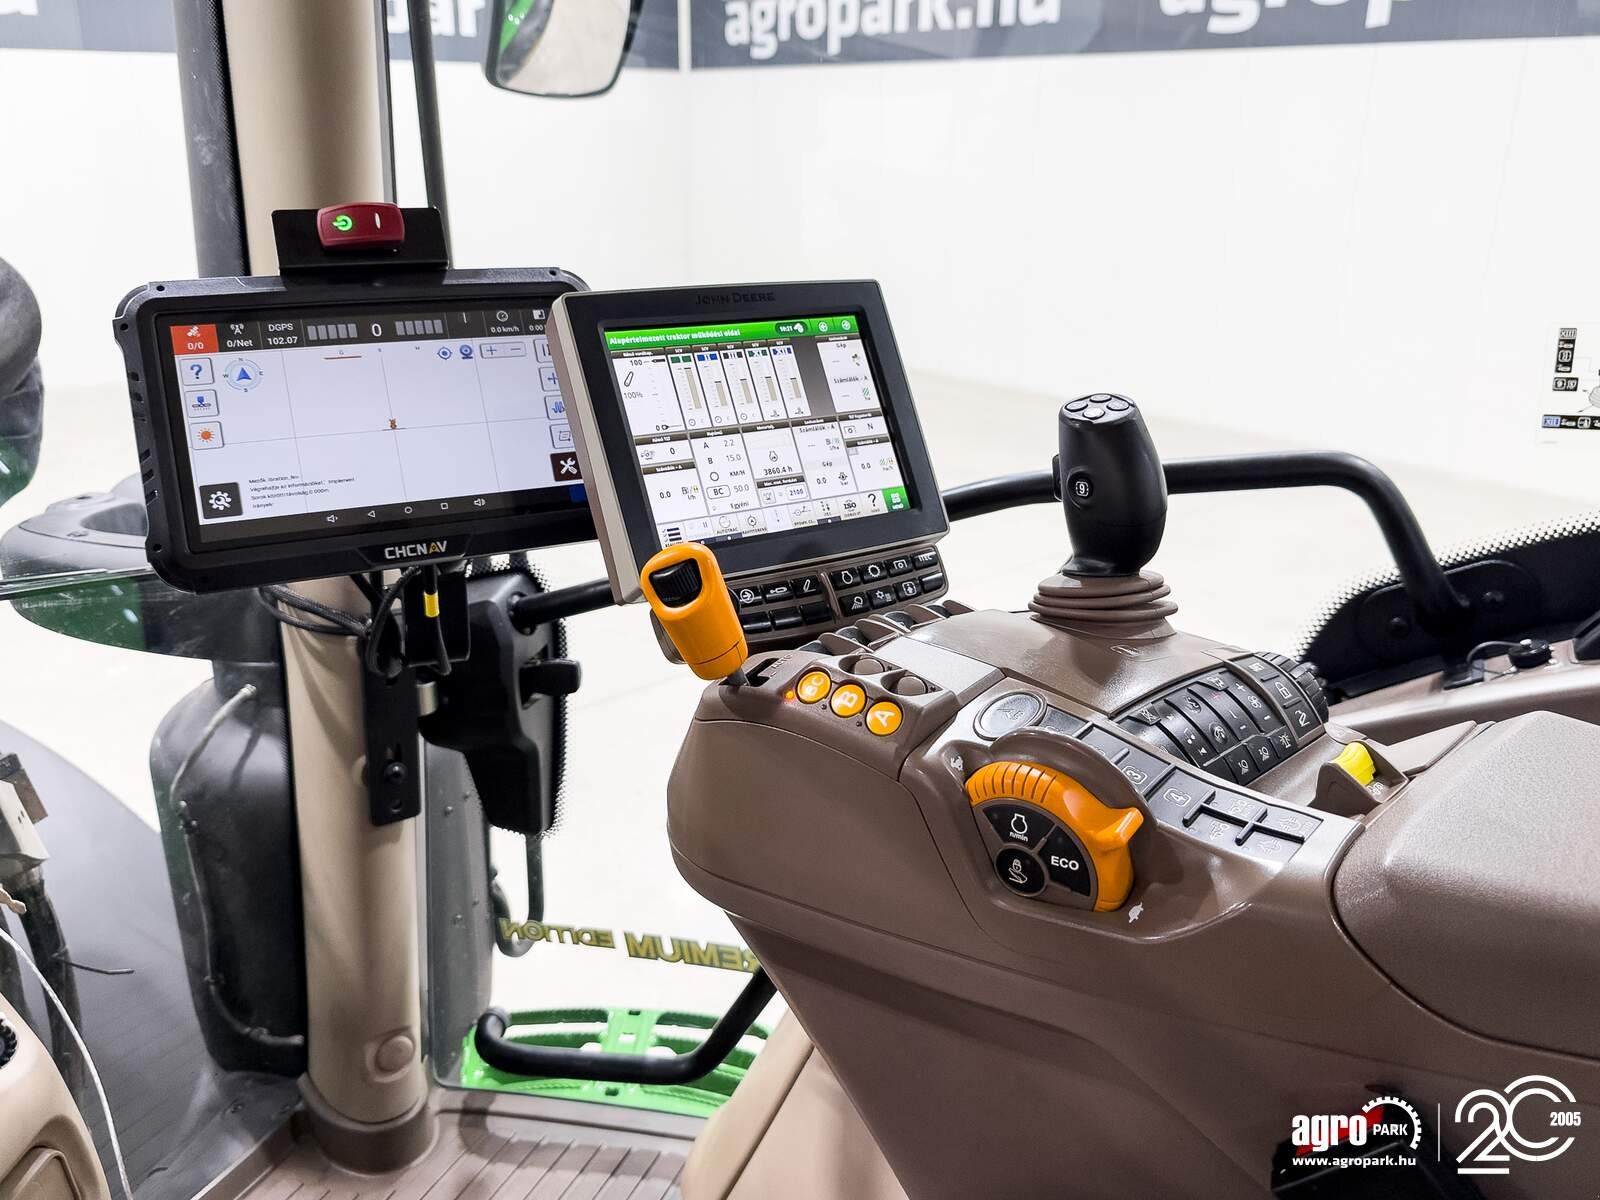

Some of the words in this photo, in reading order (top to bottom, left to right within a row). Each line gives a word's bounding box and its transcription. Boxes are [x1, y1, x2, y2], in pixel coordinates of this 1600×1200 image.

[368, 323, 383, 337] 0
[502, 325, 520, 333] km/h
[267, 337, 298, 345] 102.07
[666, 333, 690, 341] traktor
[226, 340, 253, 348] 0/Net
[703, 441, 710, 449] A
[729, 469, 746, 477] KM/H
[713, 488, 725, 496] BC
[843, 502, 857, 510] ISO
[385, 541, 447, 559] CHCNAV
[804, 676, 825, 697] BC
[837, 690, 859, 708] B
[874, 710, 895, 727] A
[1009, 831, 1029, 842] n/min
[1050, 856, 1079, 871] ECO
